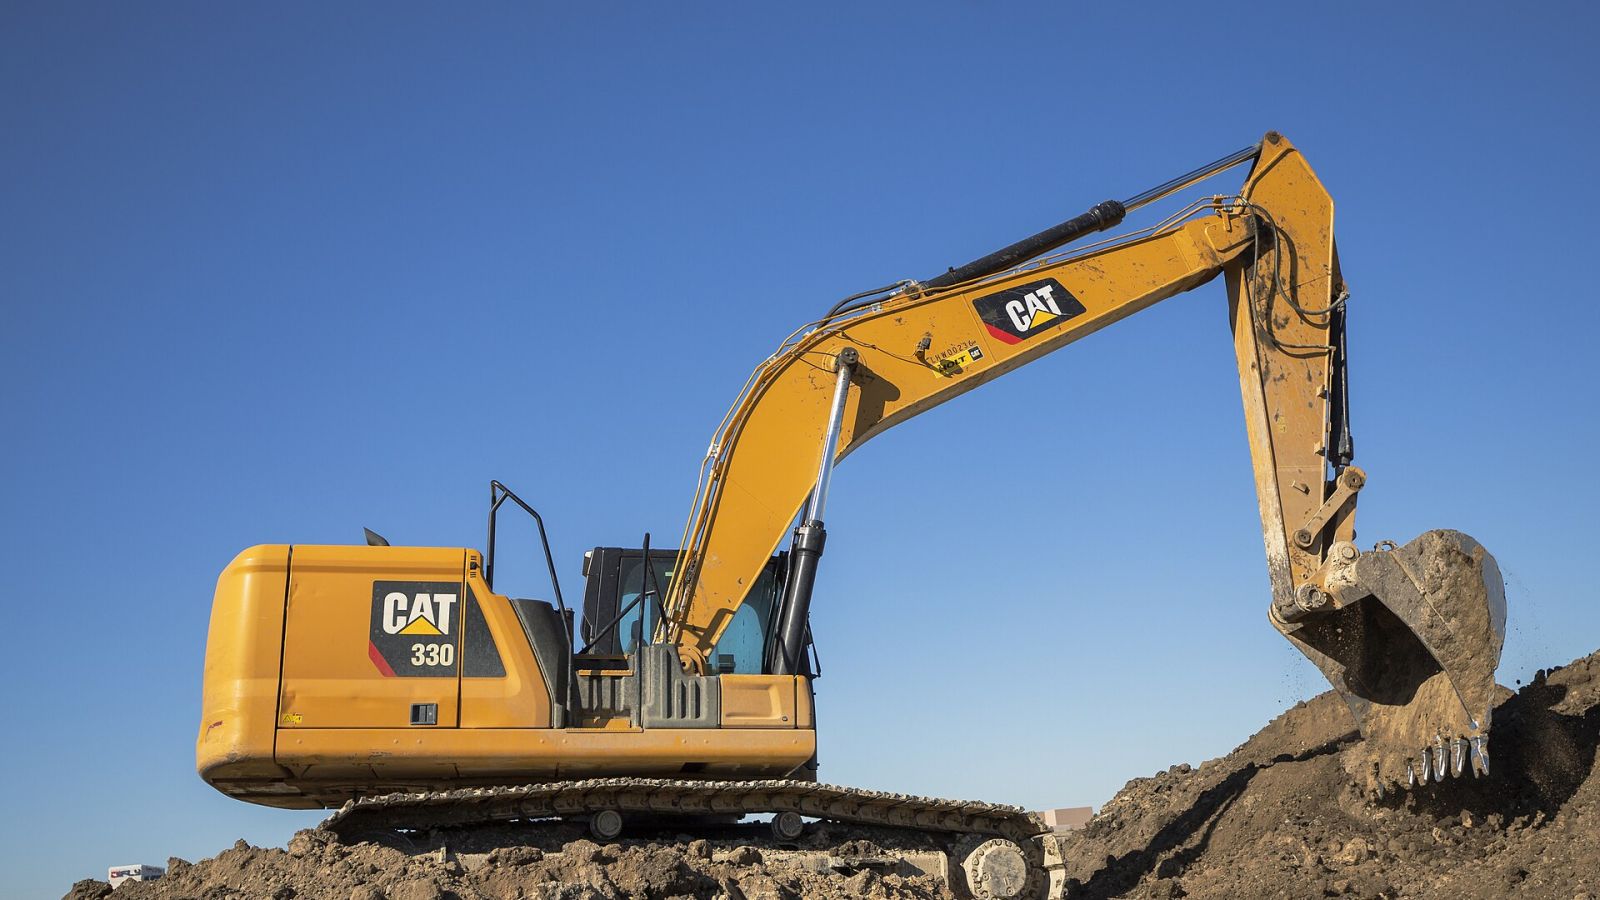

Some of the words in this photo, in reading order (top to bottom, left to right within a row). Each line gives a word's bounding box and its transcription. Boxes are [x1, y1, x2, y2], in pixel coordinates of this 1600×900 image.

[1005, 284, 1061, 332] CAT
[382, 592, 457, 635] CAT
[411, 643, 454, 666] 330
